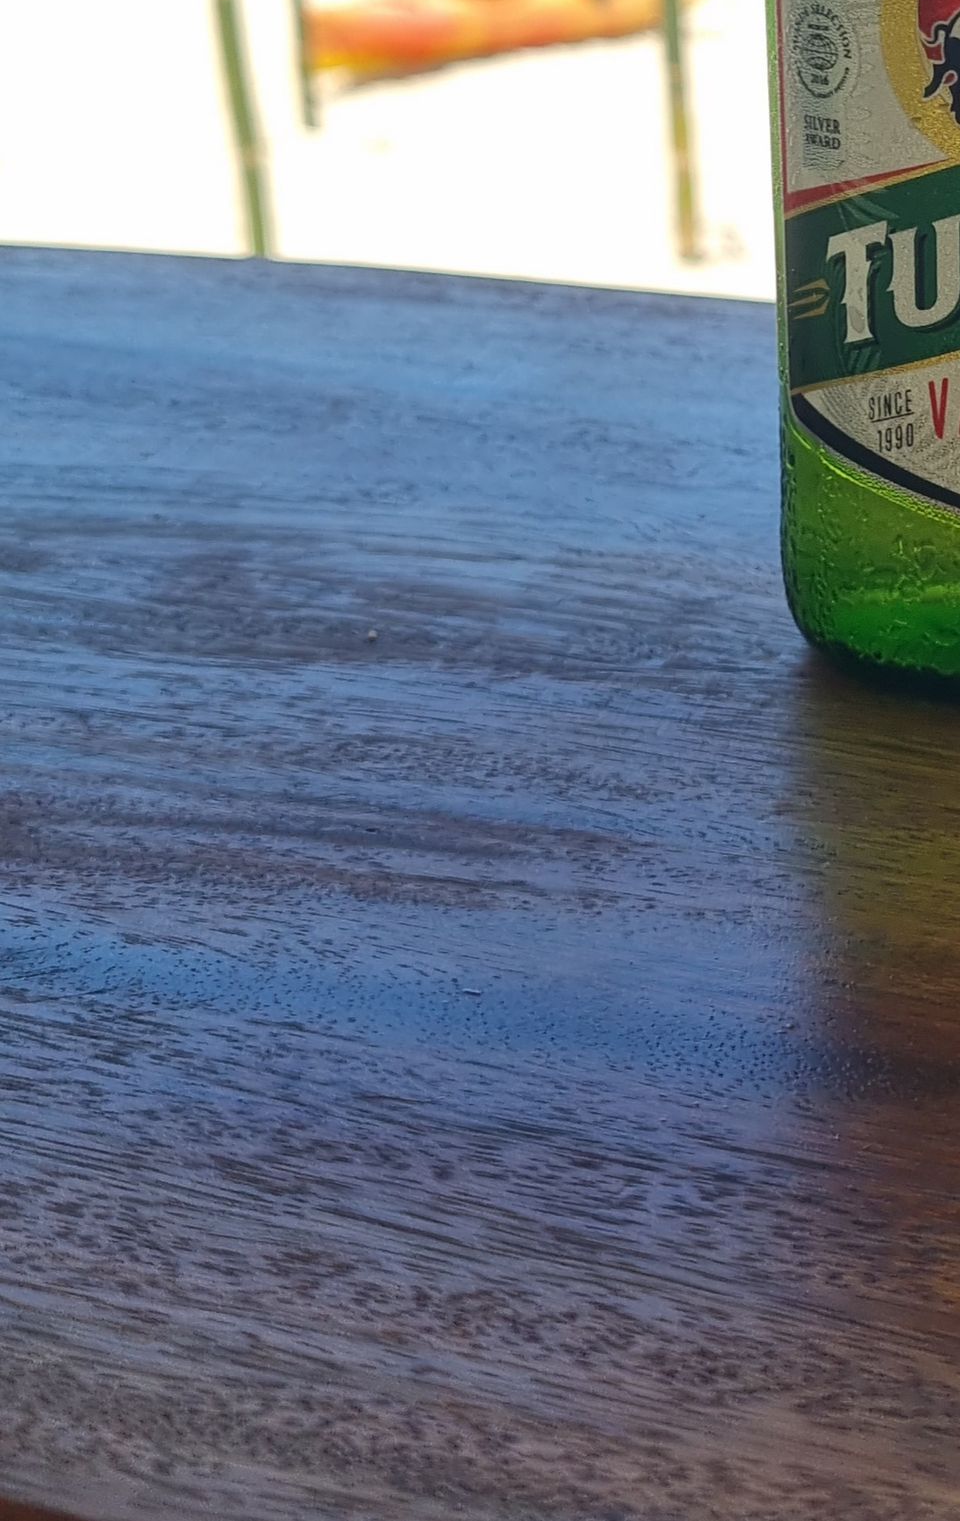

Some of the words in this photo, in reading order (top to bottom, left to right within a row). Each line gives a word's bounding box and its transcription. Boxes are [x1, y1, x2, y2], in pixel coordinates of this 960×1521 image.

[804, 114, 841, 134] SILVER
[868, 389, 913, 421] SINCE
[877, 423, 915, 453] 1990
